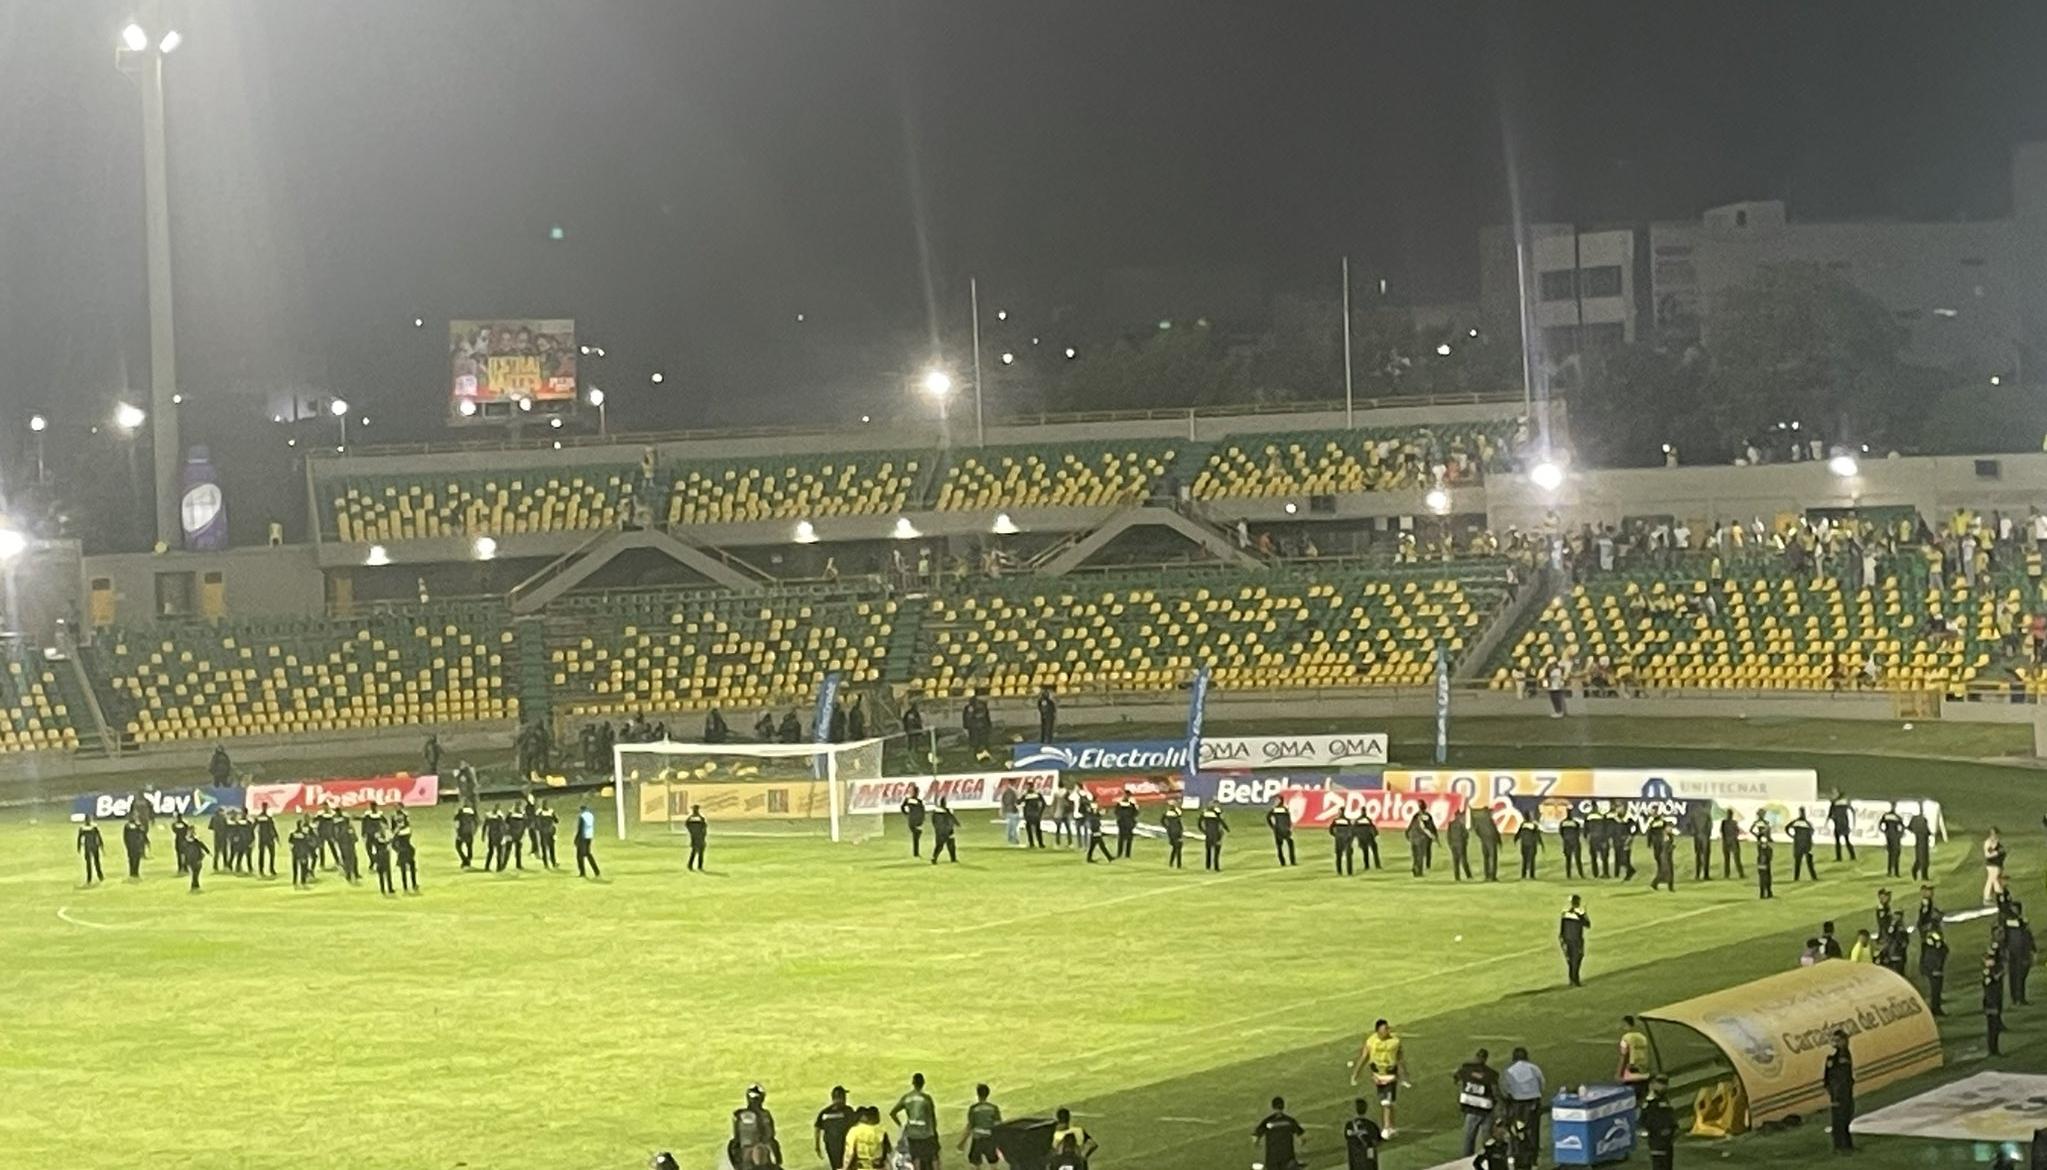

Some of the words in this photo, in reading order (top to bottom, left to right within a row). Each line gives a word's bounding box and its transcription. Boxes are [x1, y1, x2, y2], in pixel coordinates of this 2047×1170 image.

[1199, 741, 1250, 759] OMA
[1262, 740, 1316, 758] OMA
[1329, 738, 1382, 757] OMA
[924, 779, 985, 801] MEGA
[1680, 782, 1768, 794] UNITECNAR
